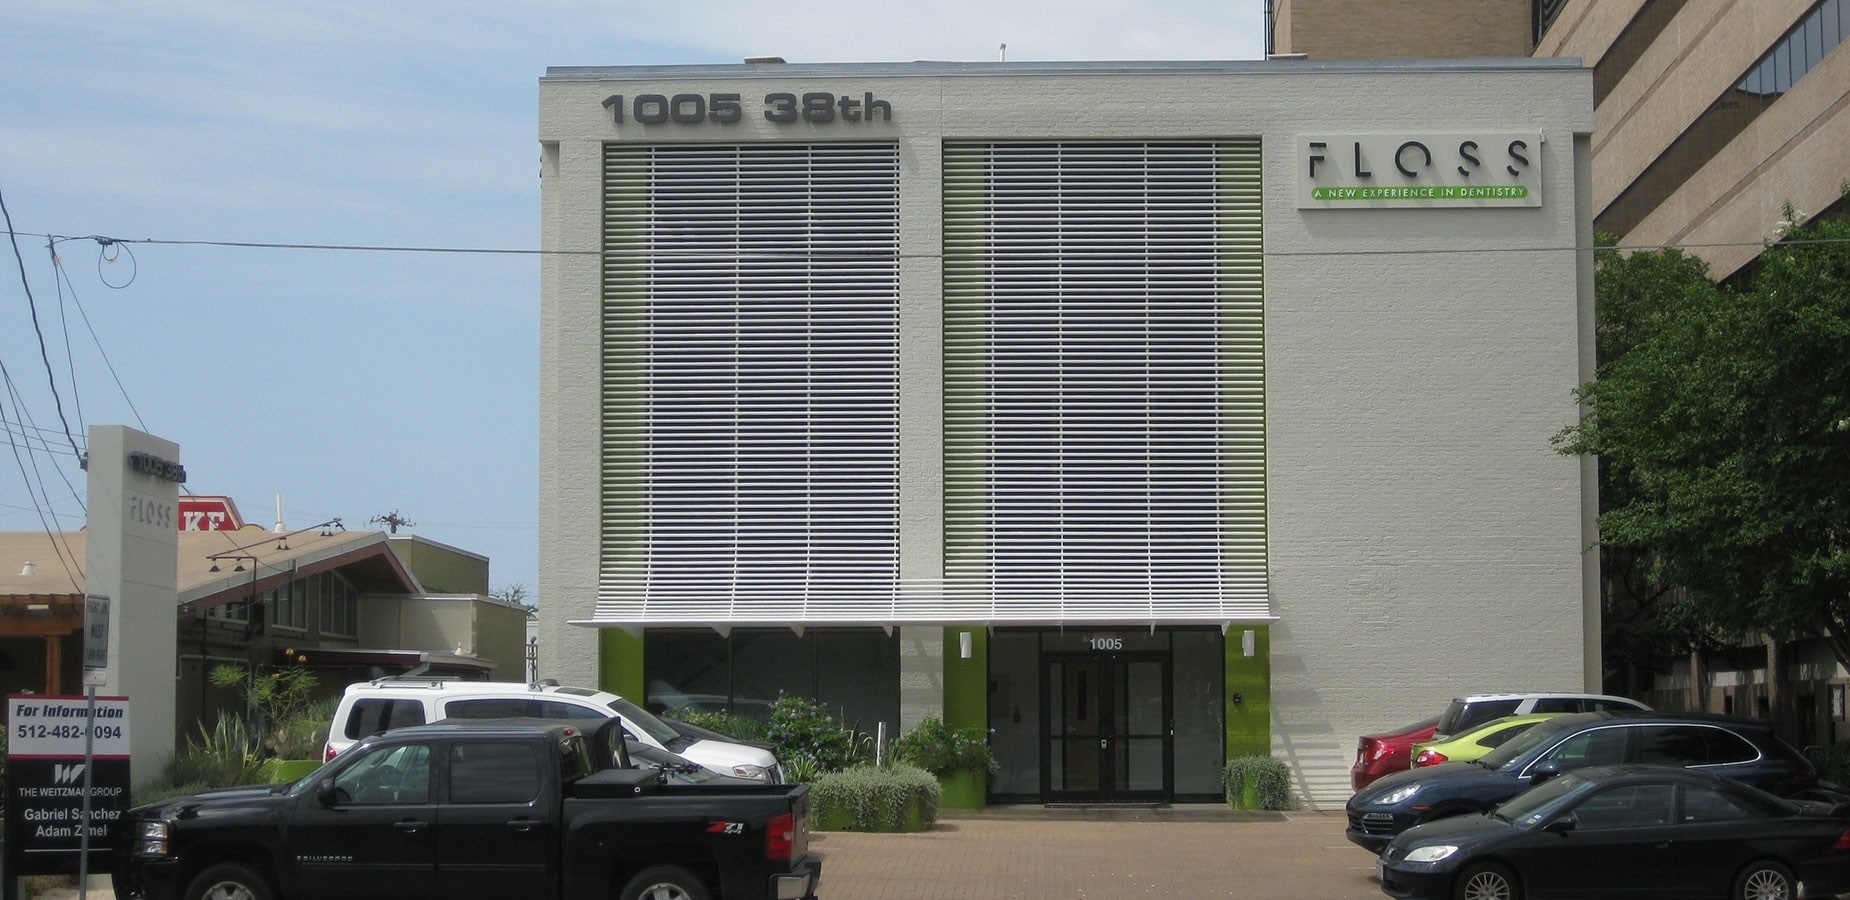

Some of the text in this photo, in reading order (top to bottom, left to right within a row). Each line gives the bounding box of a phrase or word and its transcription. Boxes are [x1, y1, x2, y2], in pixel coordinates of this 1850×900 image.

[601, 92, 892, 124] 1005 38th
[1309, 140, 1529, 178] FLOSS
[1314, 187, 1525, 198] A NEW EXPERIENCE IN DENTISTRY
[131, 497, 171, 528] FLOSS
[1090, 638, 1123, 650] 1005
[16, 704, 124, 719] For Informtion
[19, 787, 38, 797] THE
[90, 787, 122, 797] GROUP
[24, 807, 68, 820] Gabriel
[36, 823, 107, 837] Adam Zmel
